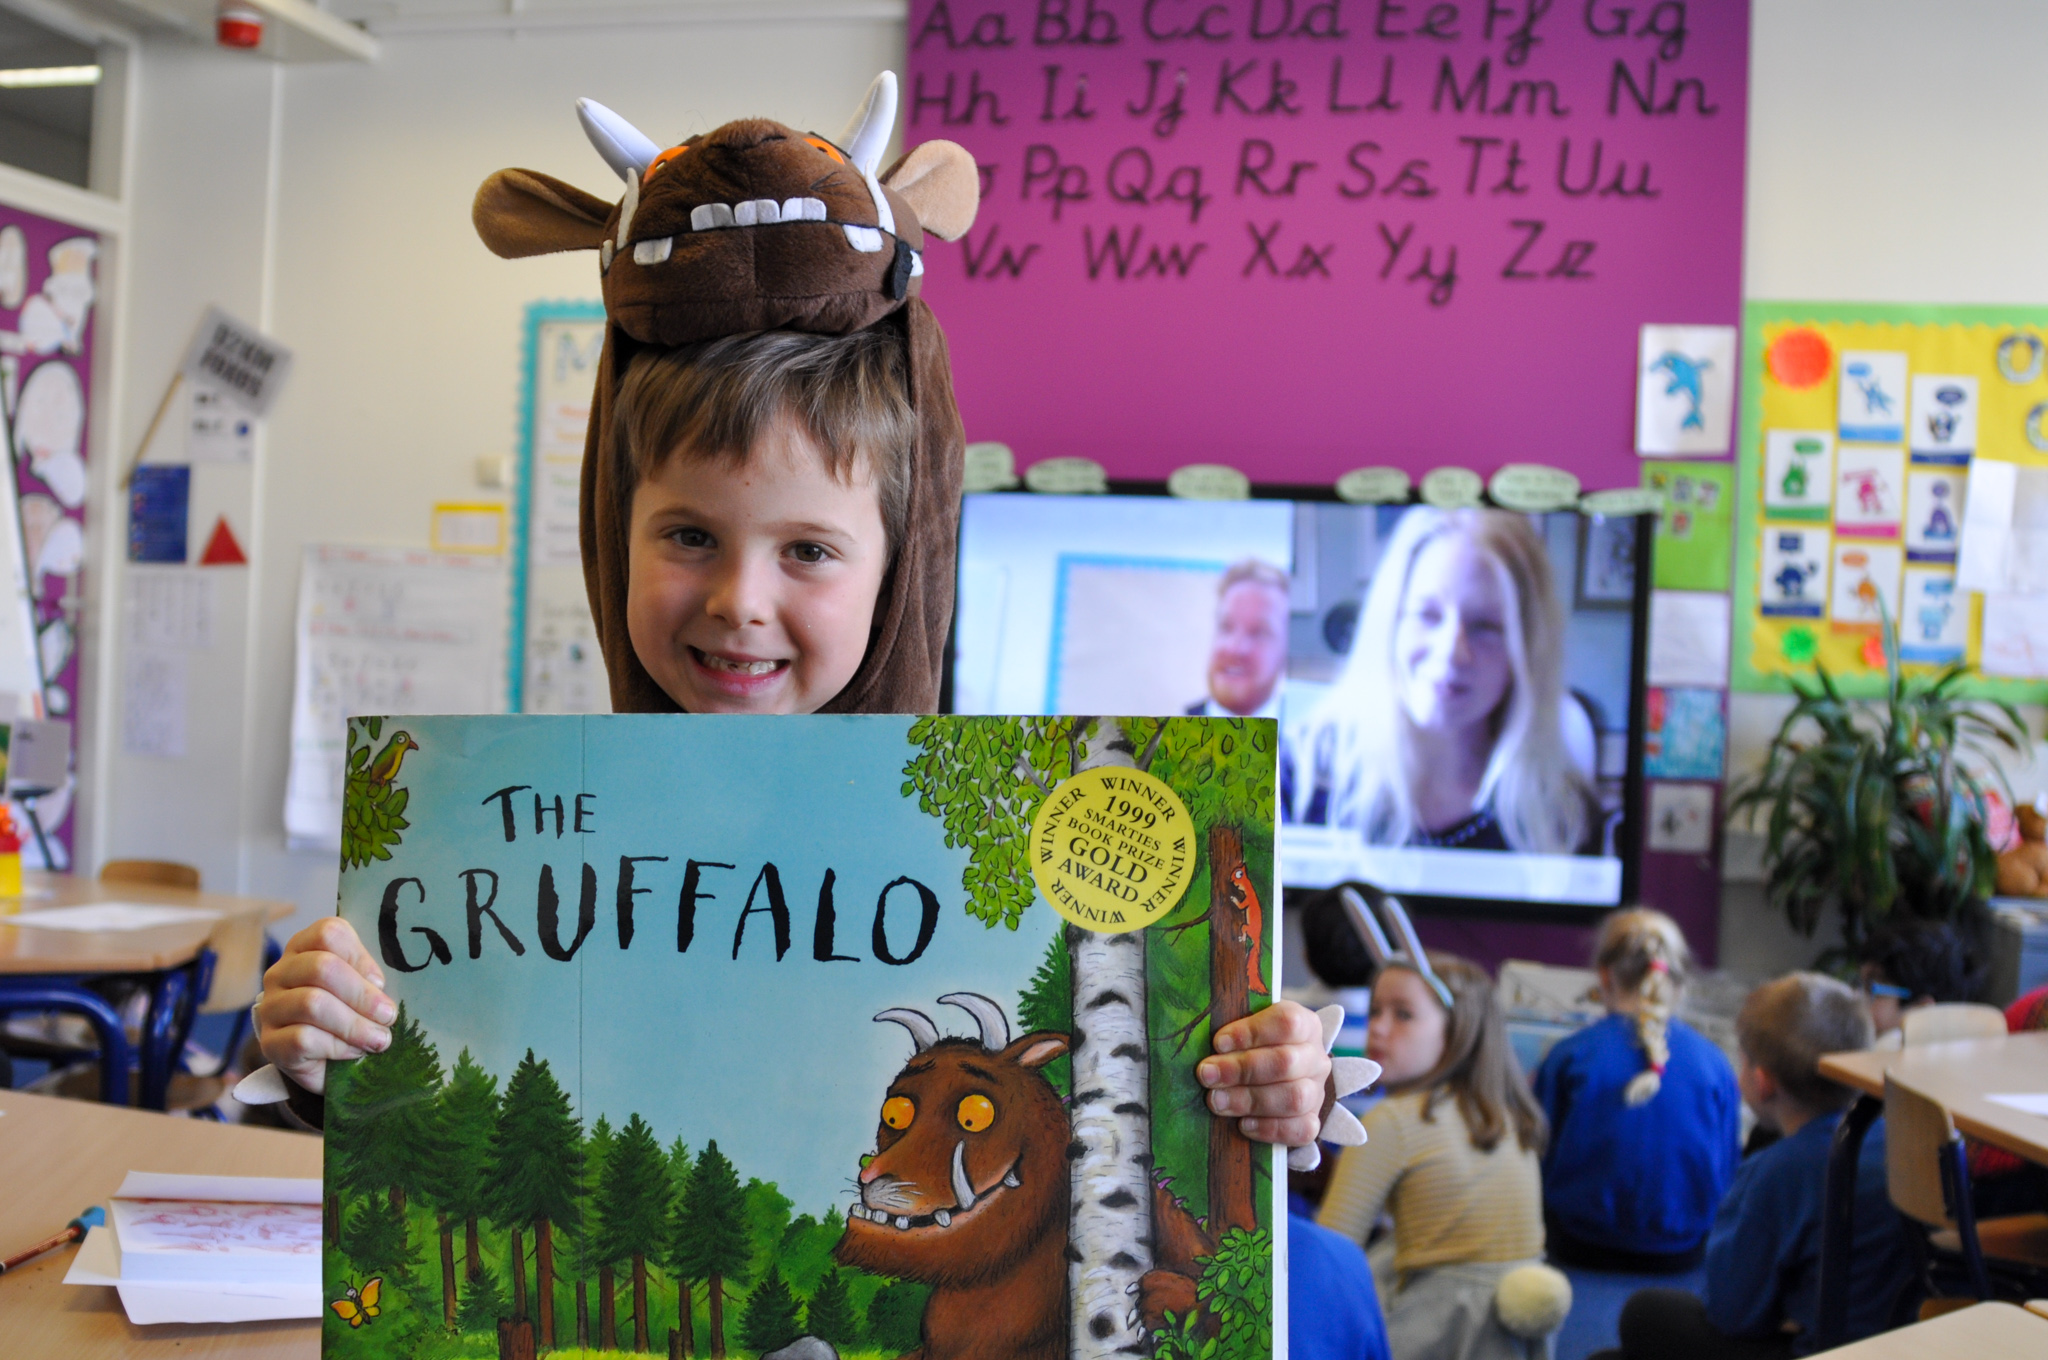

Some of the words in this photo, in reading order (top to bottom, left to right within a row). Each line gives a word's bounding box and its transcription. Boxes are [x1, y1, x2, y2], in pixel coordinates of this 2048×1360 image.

[913, 0, 1013, 48] Aa
[1034, 0, 1120, 46] Bb
[1143, 0, 1234, 42] Cc
[1249, 0, 1347, 40] Dd
[1375, 0, 1461, 41] Ee
[1587, 0, 1689, 61] Gg
[911, 70, 1010, 126] Hh
[1040, 64, 1096, 121] Ii
[1128, 60, 1187, 138] Jj
[1213, 58, 1302, 116] Kk
[1328, 55, 1400, 113] Ll
[1432, 57, 1570, 116] Mm
[1607, 58, 1719, 118] Nn
[1021, 144, 1093, 221] Pp
[1108, 147, 1211, 223] Qq
[1235, 140, 1318, 197] Rr
[1337, 141, 1439, 200] Ss
[1458, 136, 1529, 196] Tt
[1557, 137, 1661, 198] Uu
[962, 224, 1040, 279] Vv
[1084, 224, 1206, 280] Ww
[1242, 221, 1335, 279] Xx
[1377, 221, 1460, 305] Yy
[1501, 220, 1597, 280] Zz
[482, 785, 597, 842] THE
[1040, 787, 1087, 864] WINNER
[1101, 776, 1175, 823] WINNER
[1104, 795, 1156, 829] 1999
[1068, 817, 1111, 846] BOOK
[1118, 840, 1165, 870] PRIZE
[1084, 808, 1161, 851] SMARTIES
[1058, 858, 1139, 903] AWARD
[1069, 836, 1148, 884] GOLD
[1140, 836, 1186, 913] WINNER
[378, 855, 941, 973] GRUFFALO
[1051, 877, 1127, 924] WINNER
